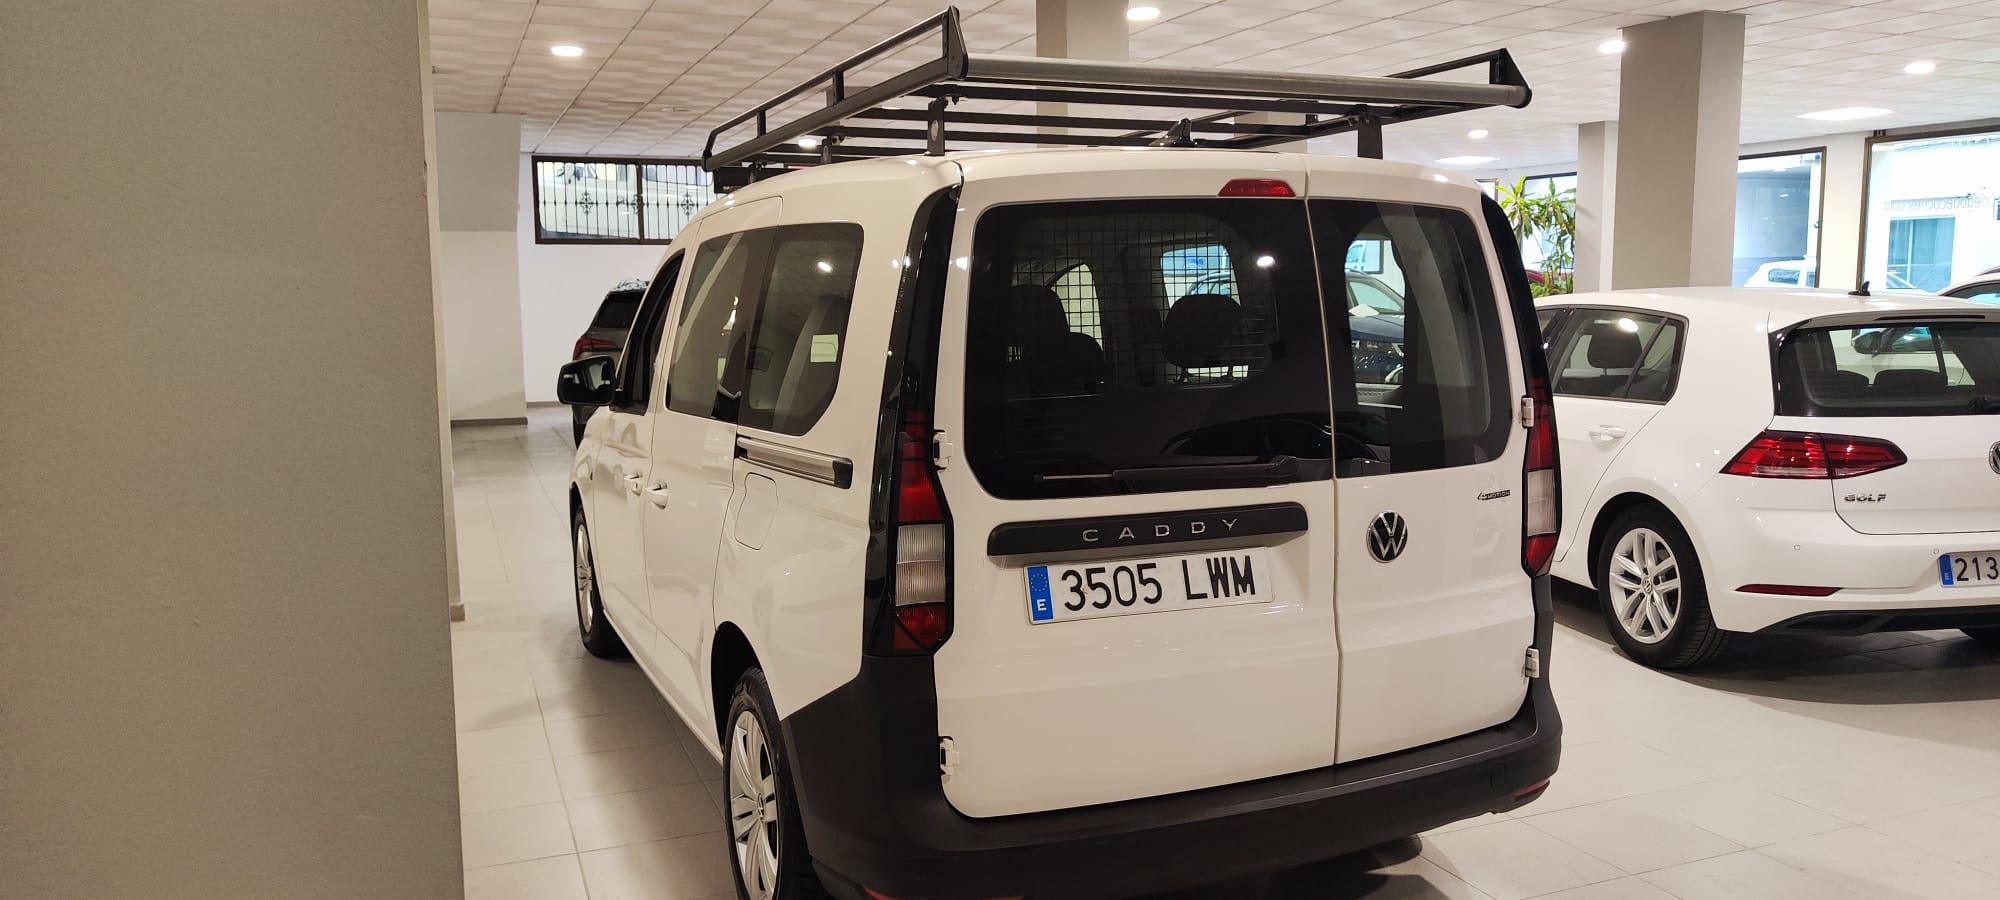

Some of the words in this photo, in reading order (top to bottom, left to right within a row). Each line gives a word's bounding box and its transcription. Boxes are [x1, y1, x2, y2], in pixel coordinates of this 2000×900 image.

[1844, 493, 1887, 502] GOLF
[1082, 518, 1238, 542] CADDY
[1954, 556, 1999, 582] 213
[1061, 562, 1163, 612] 3505
[1181, 554, 1256, 601] LWM
[1036, 598, 1047, 612] E
